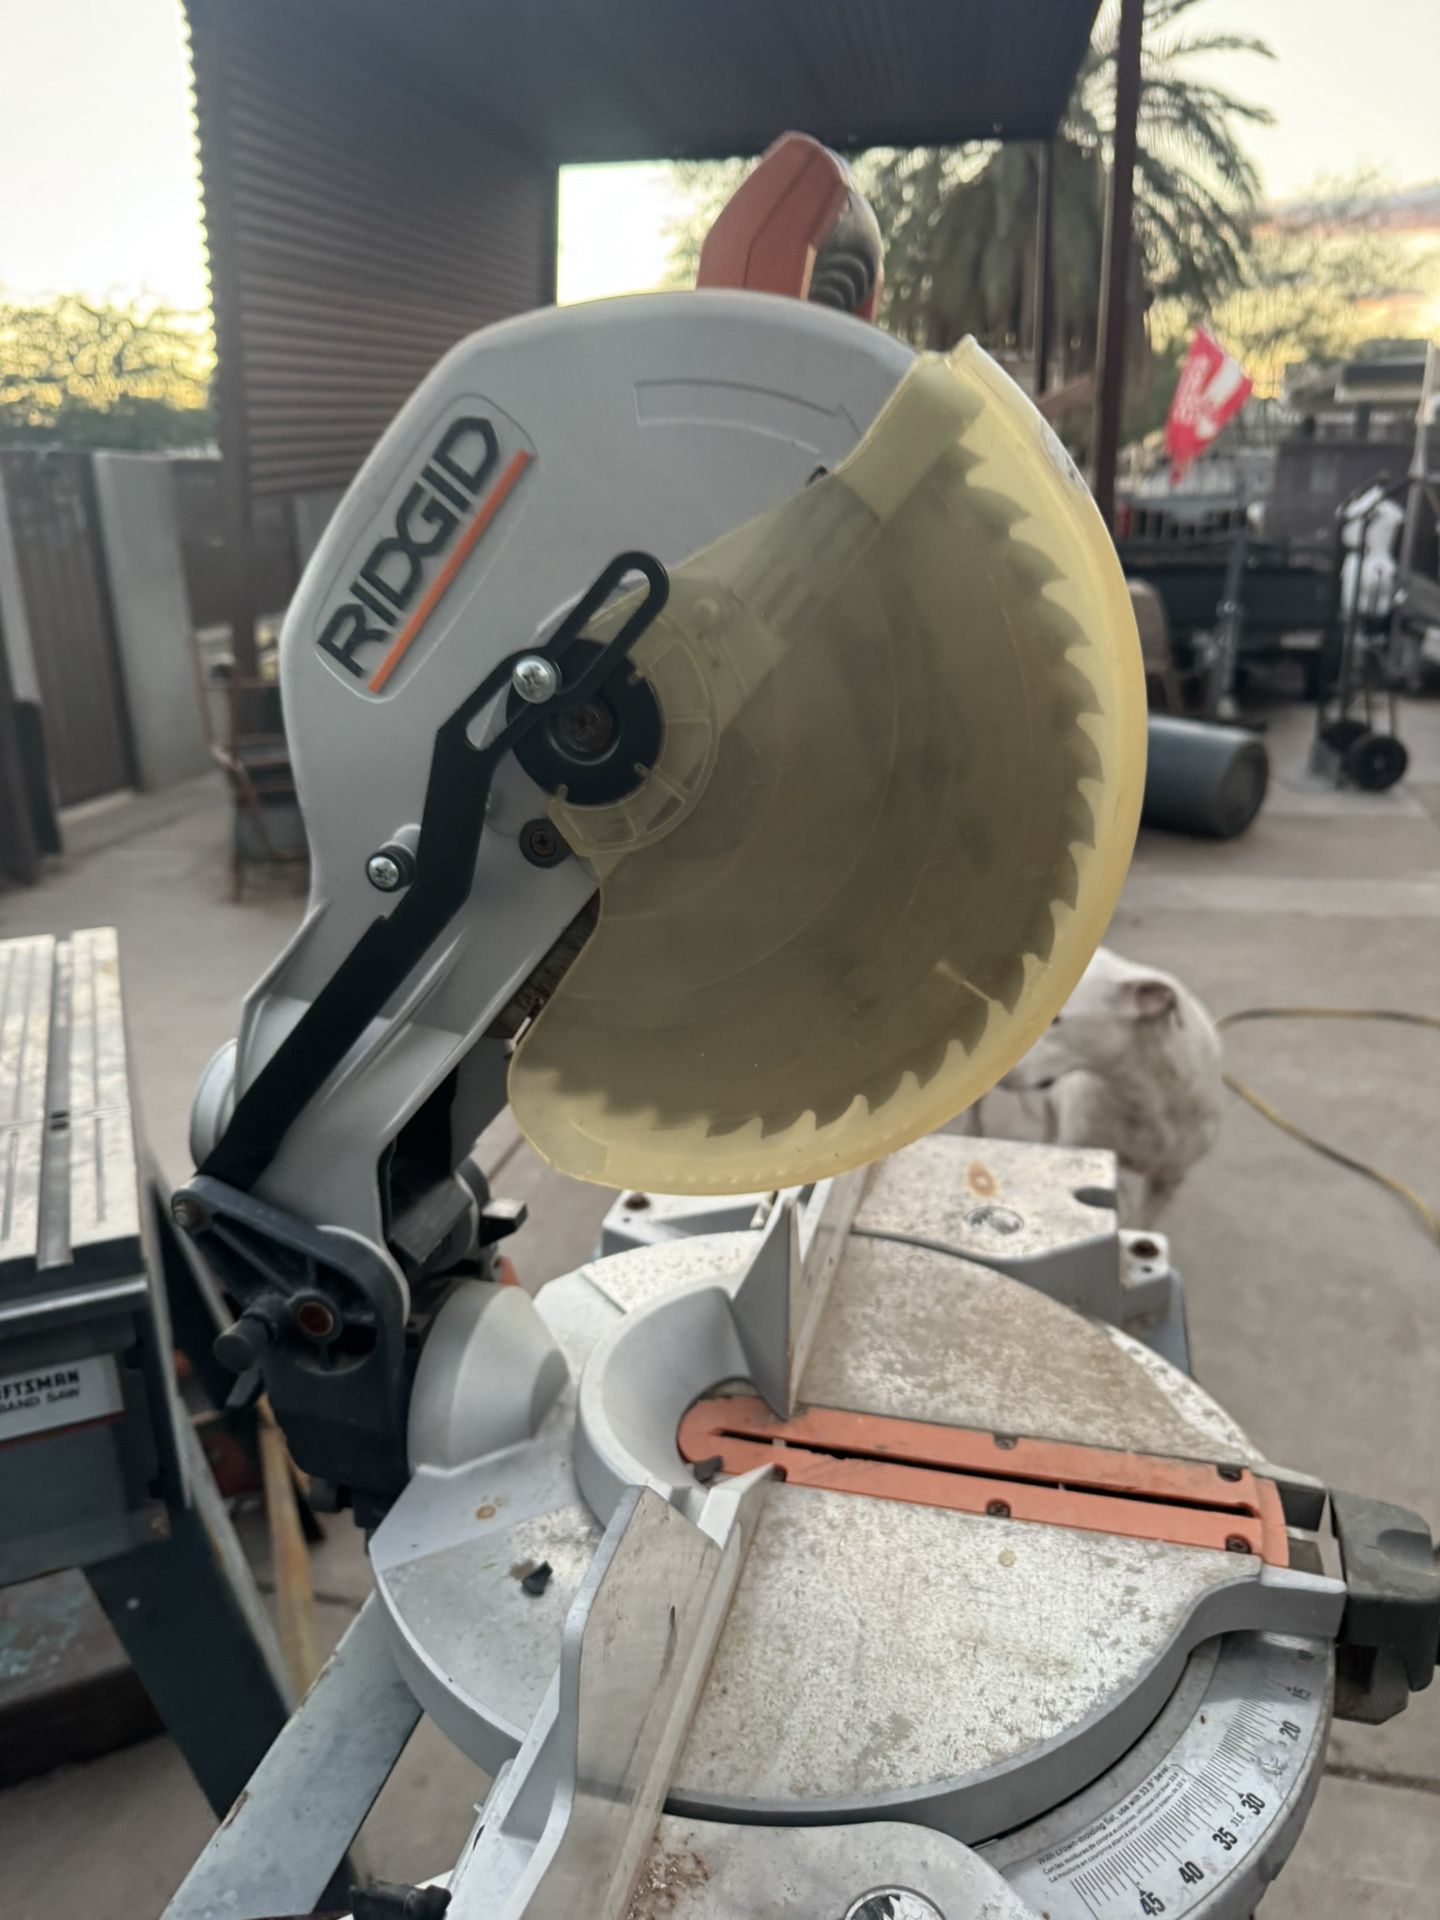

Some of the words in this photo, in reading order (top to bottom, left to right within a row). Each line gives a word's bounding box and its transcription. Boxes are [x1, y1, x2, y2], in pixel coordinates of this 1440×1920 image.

[318, 416, 499, 678] RIDGID
[0, 1369, 79, 1401] FTSMAN
[1279, 1720, 1301, 1741] 20
[1241, 1792, 1266, 1815] 30
[1212, 1826, 1238, 1851] 35
[1179, 1861, 1204, 1884] 40
[1140, 1891, 1166, 1917] 45
